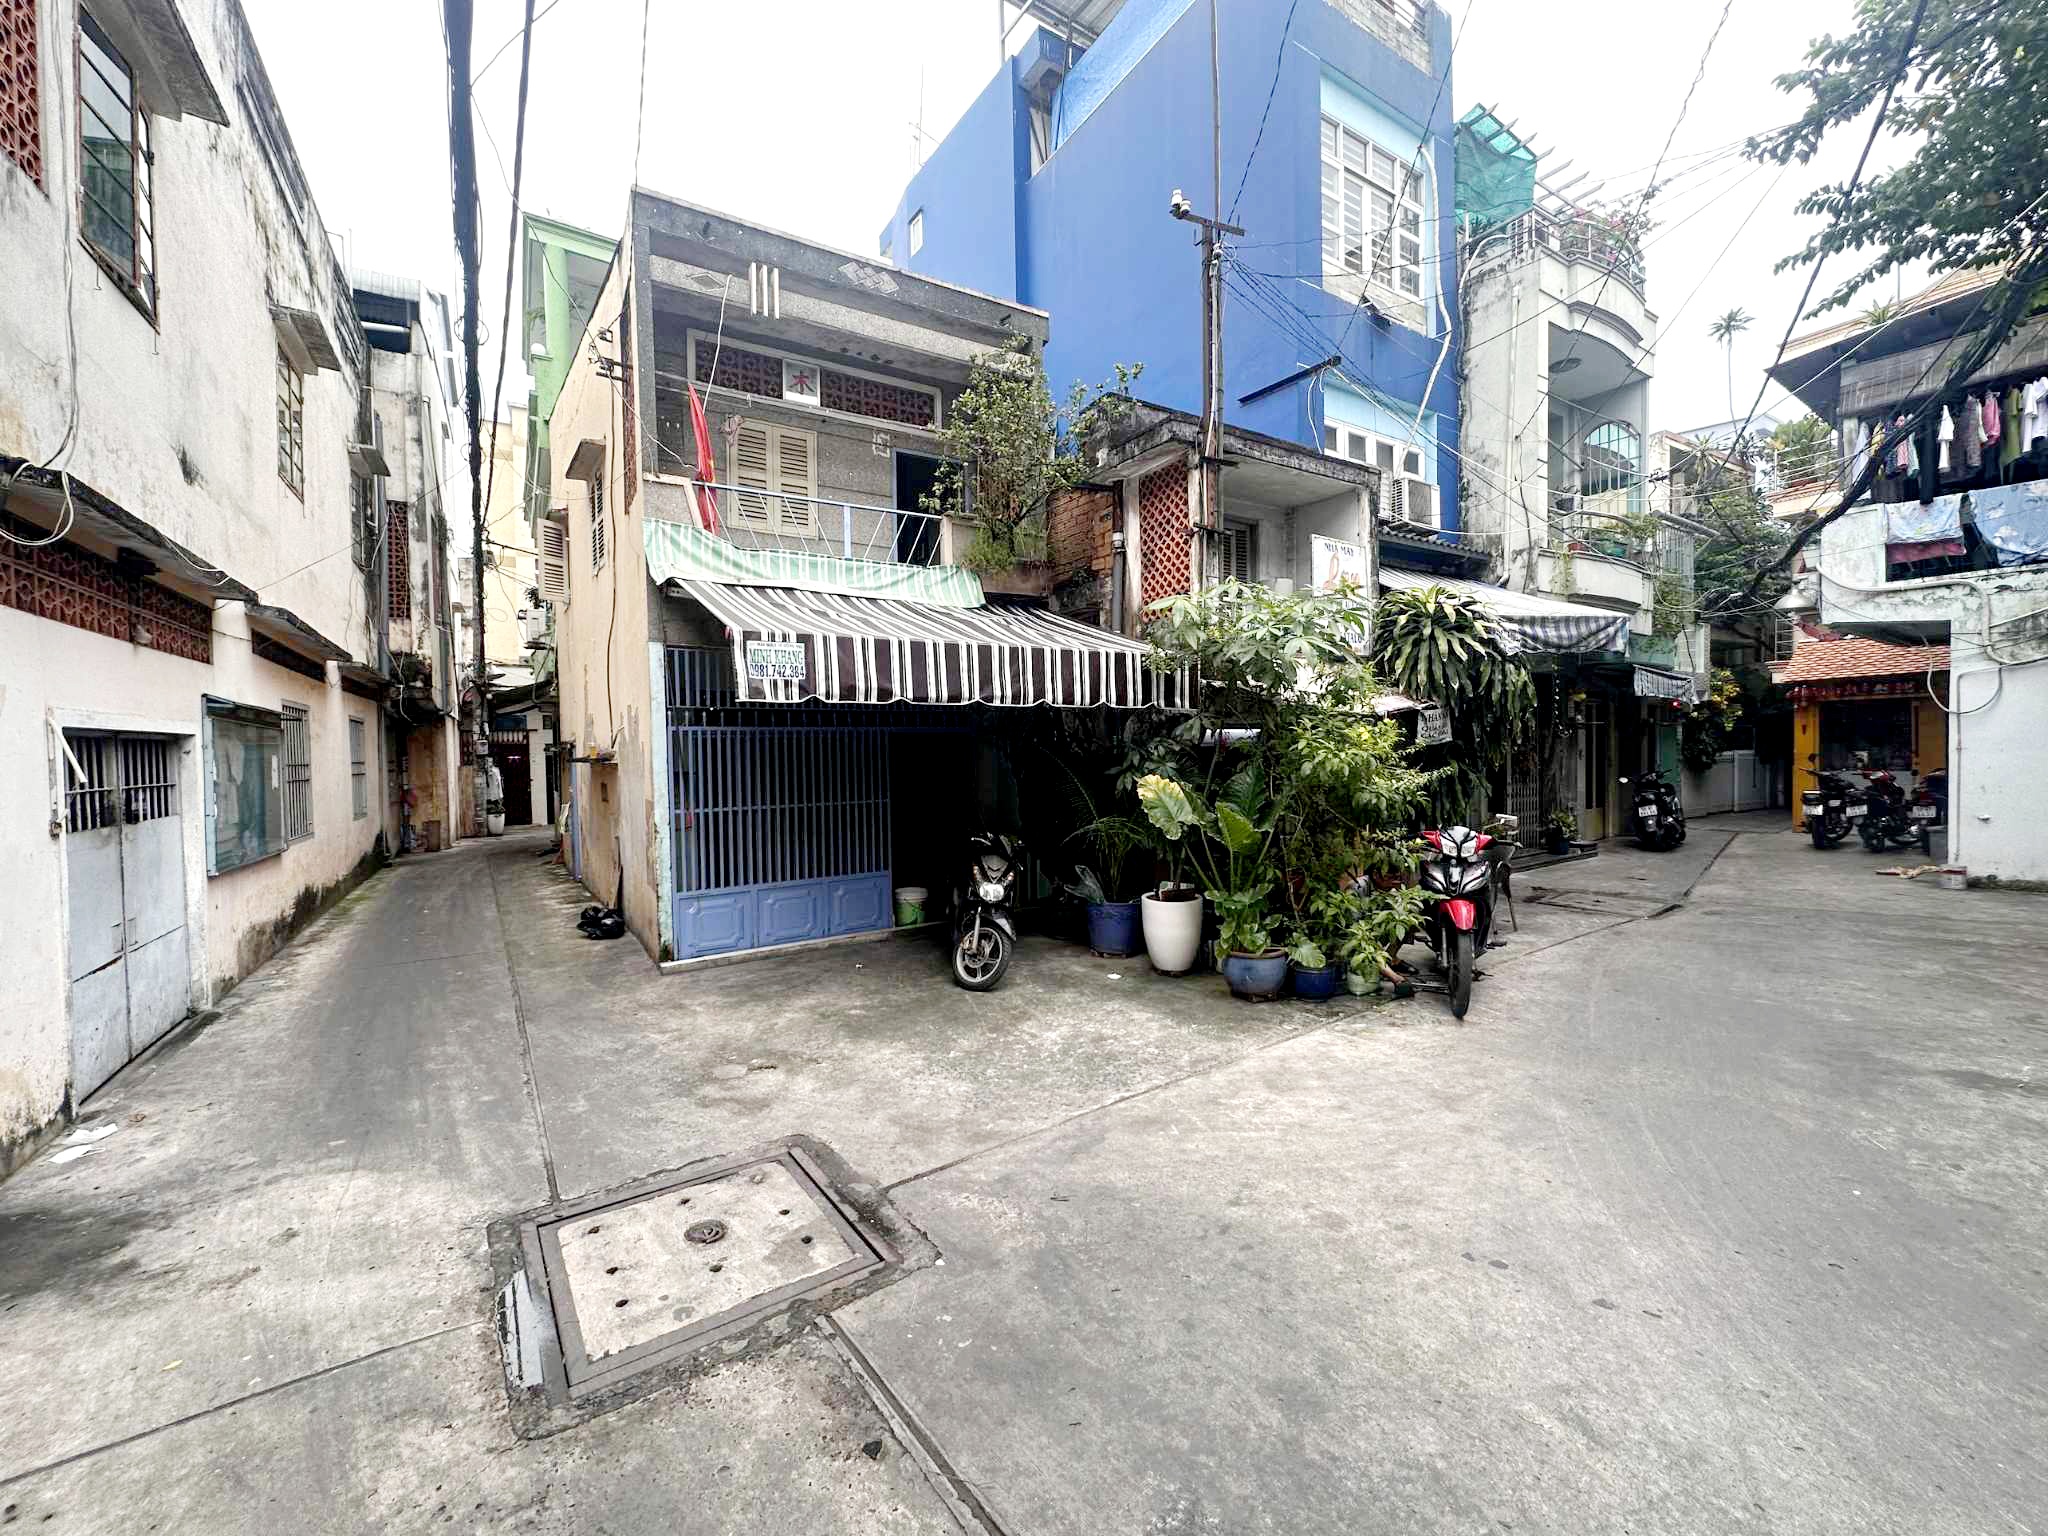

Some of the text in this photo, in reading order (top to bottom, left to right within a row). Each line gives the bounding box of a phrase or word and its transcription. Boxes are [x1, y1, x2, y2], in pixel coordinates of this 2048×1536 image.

[749, 647, 804, 665] MINH KHANG
[749, 663, 805, 678] 0981.742.384
